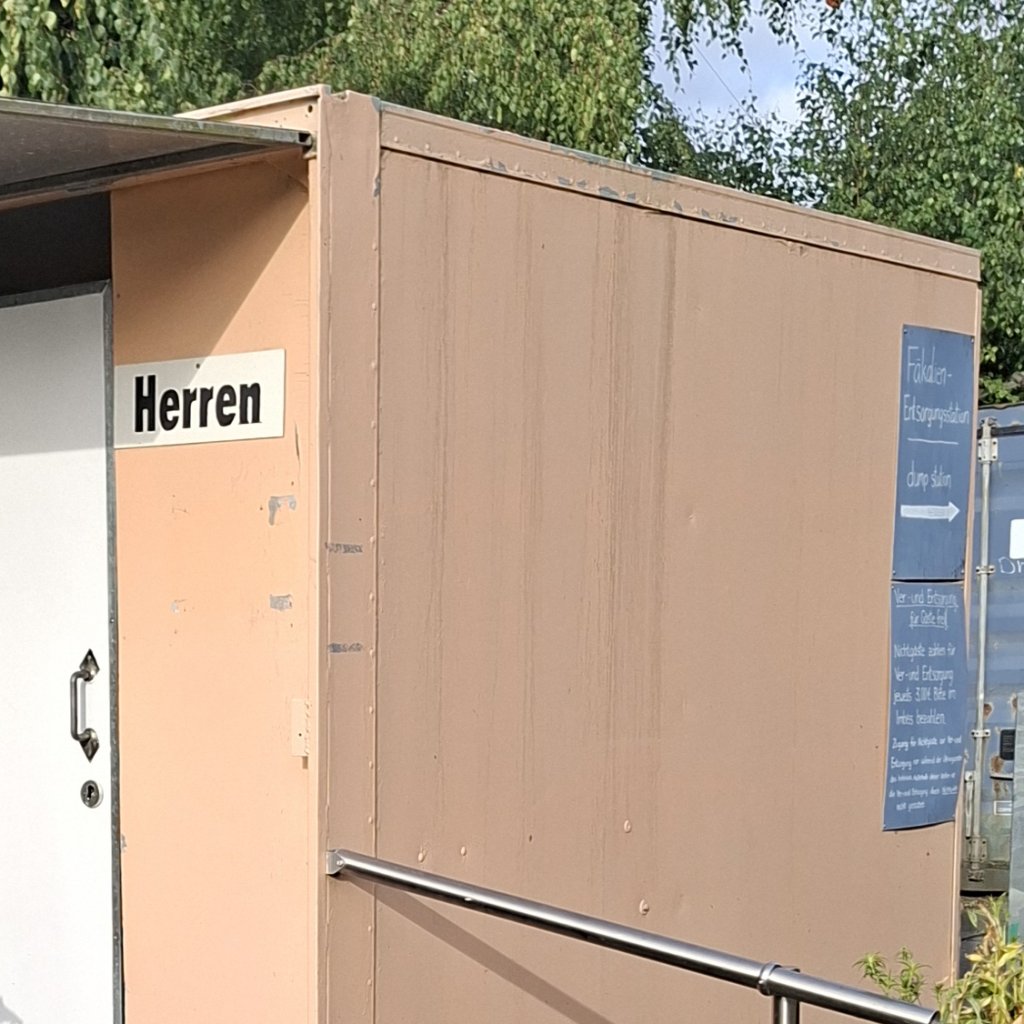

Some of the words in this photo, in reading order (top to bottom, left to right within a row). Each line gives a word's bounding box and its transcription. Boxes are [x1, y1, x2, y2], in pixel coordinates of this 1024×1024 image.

[907, 345, 952, 386] Fäkalien-
[133, 374, 263, 433] Herren
[903, 394, 970, 429] Entsorgungsstation
[906, 460, 929, 493] dump
[930, 464, 952, 489] station
